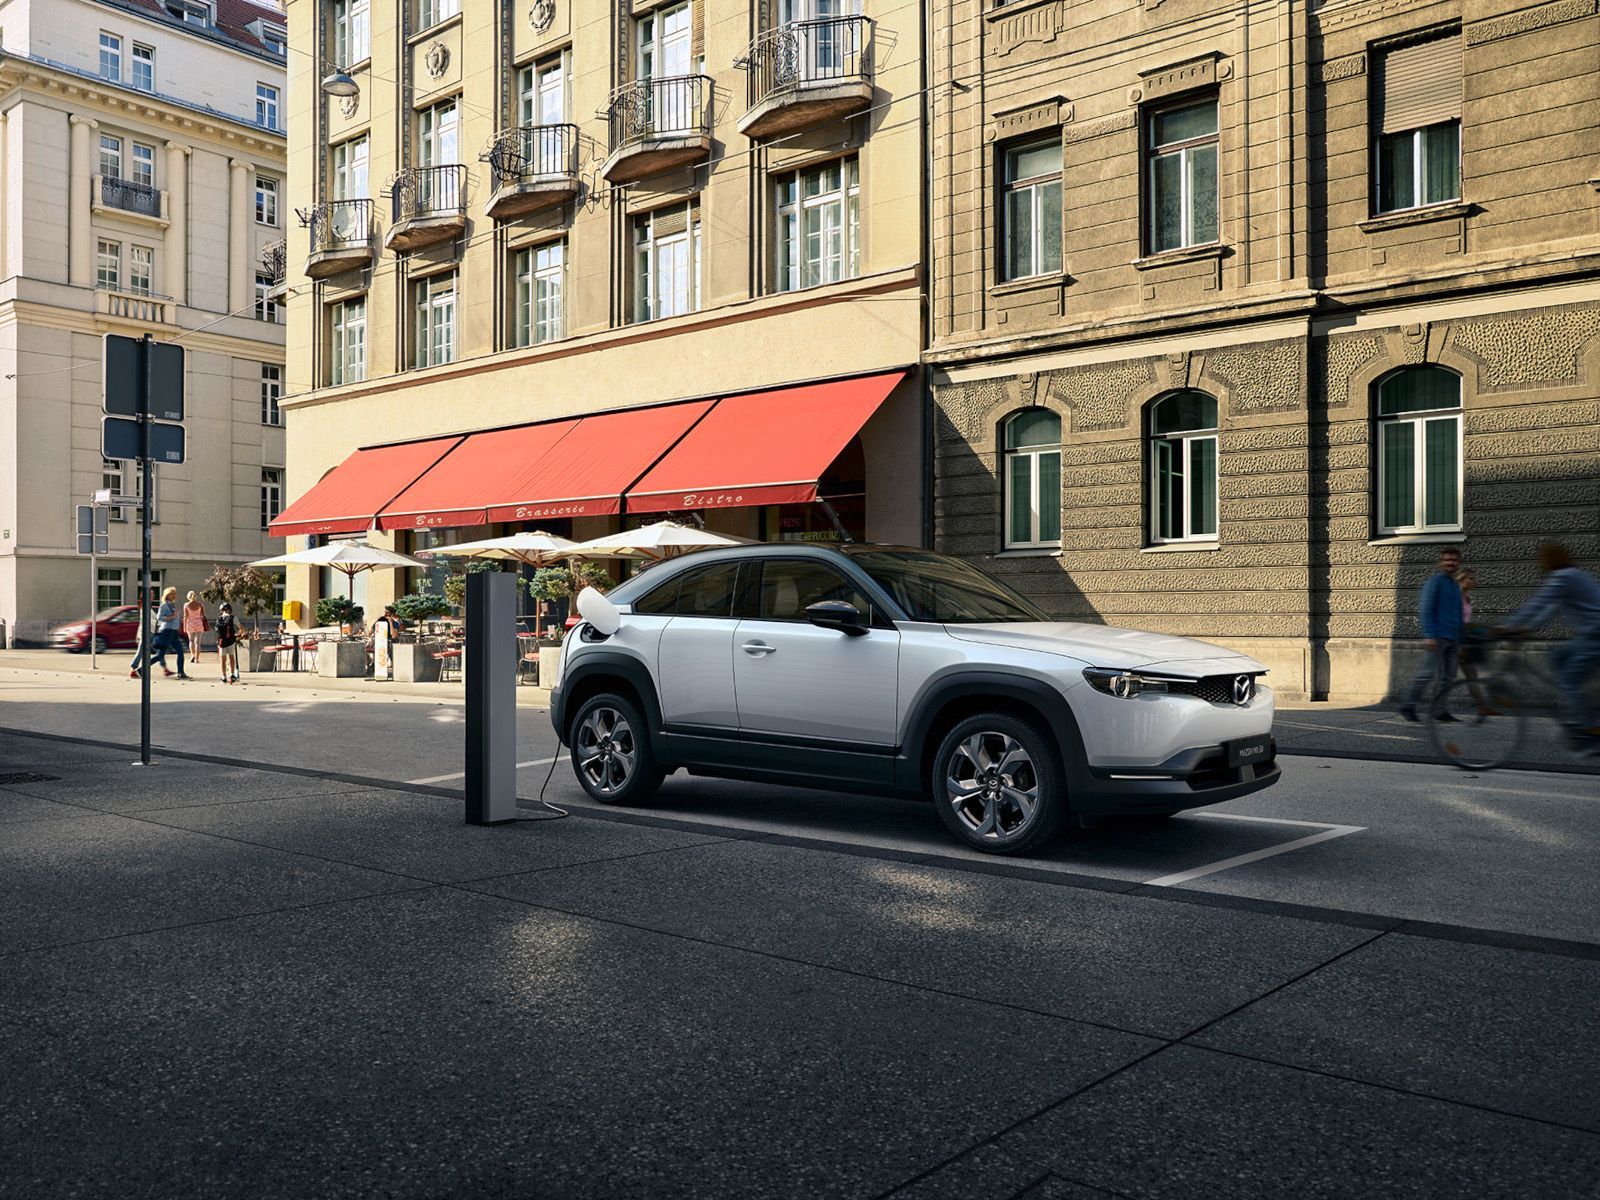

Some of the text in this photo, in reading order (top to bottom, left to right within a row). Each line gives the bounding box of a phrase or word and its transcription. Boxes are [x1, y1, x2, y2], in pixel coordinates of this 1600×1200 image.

[683, 494, 743, 506] Bistro
[515, 505, 585, 518] Brasserie
[416, 515, 443, 525] Bar
